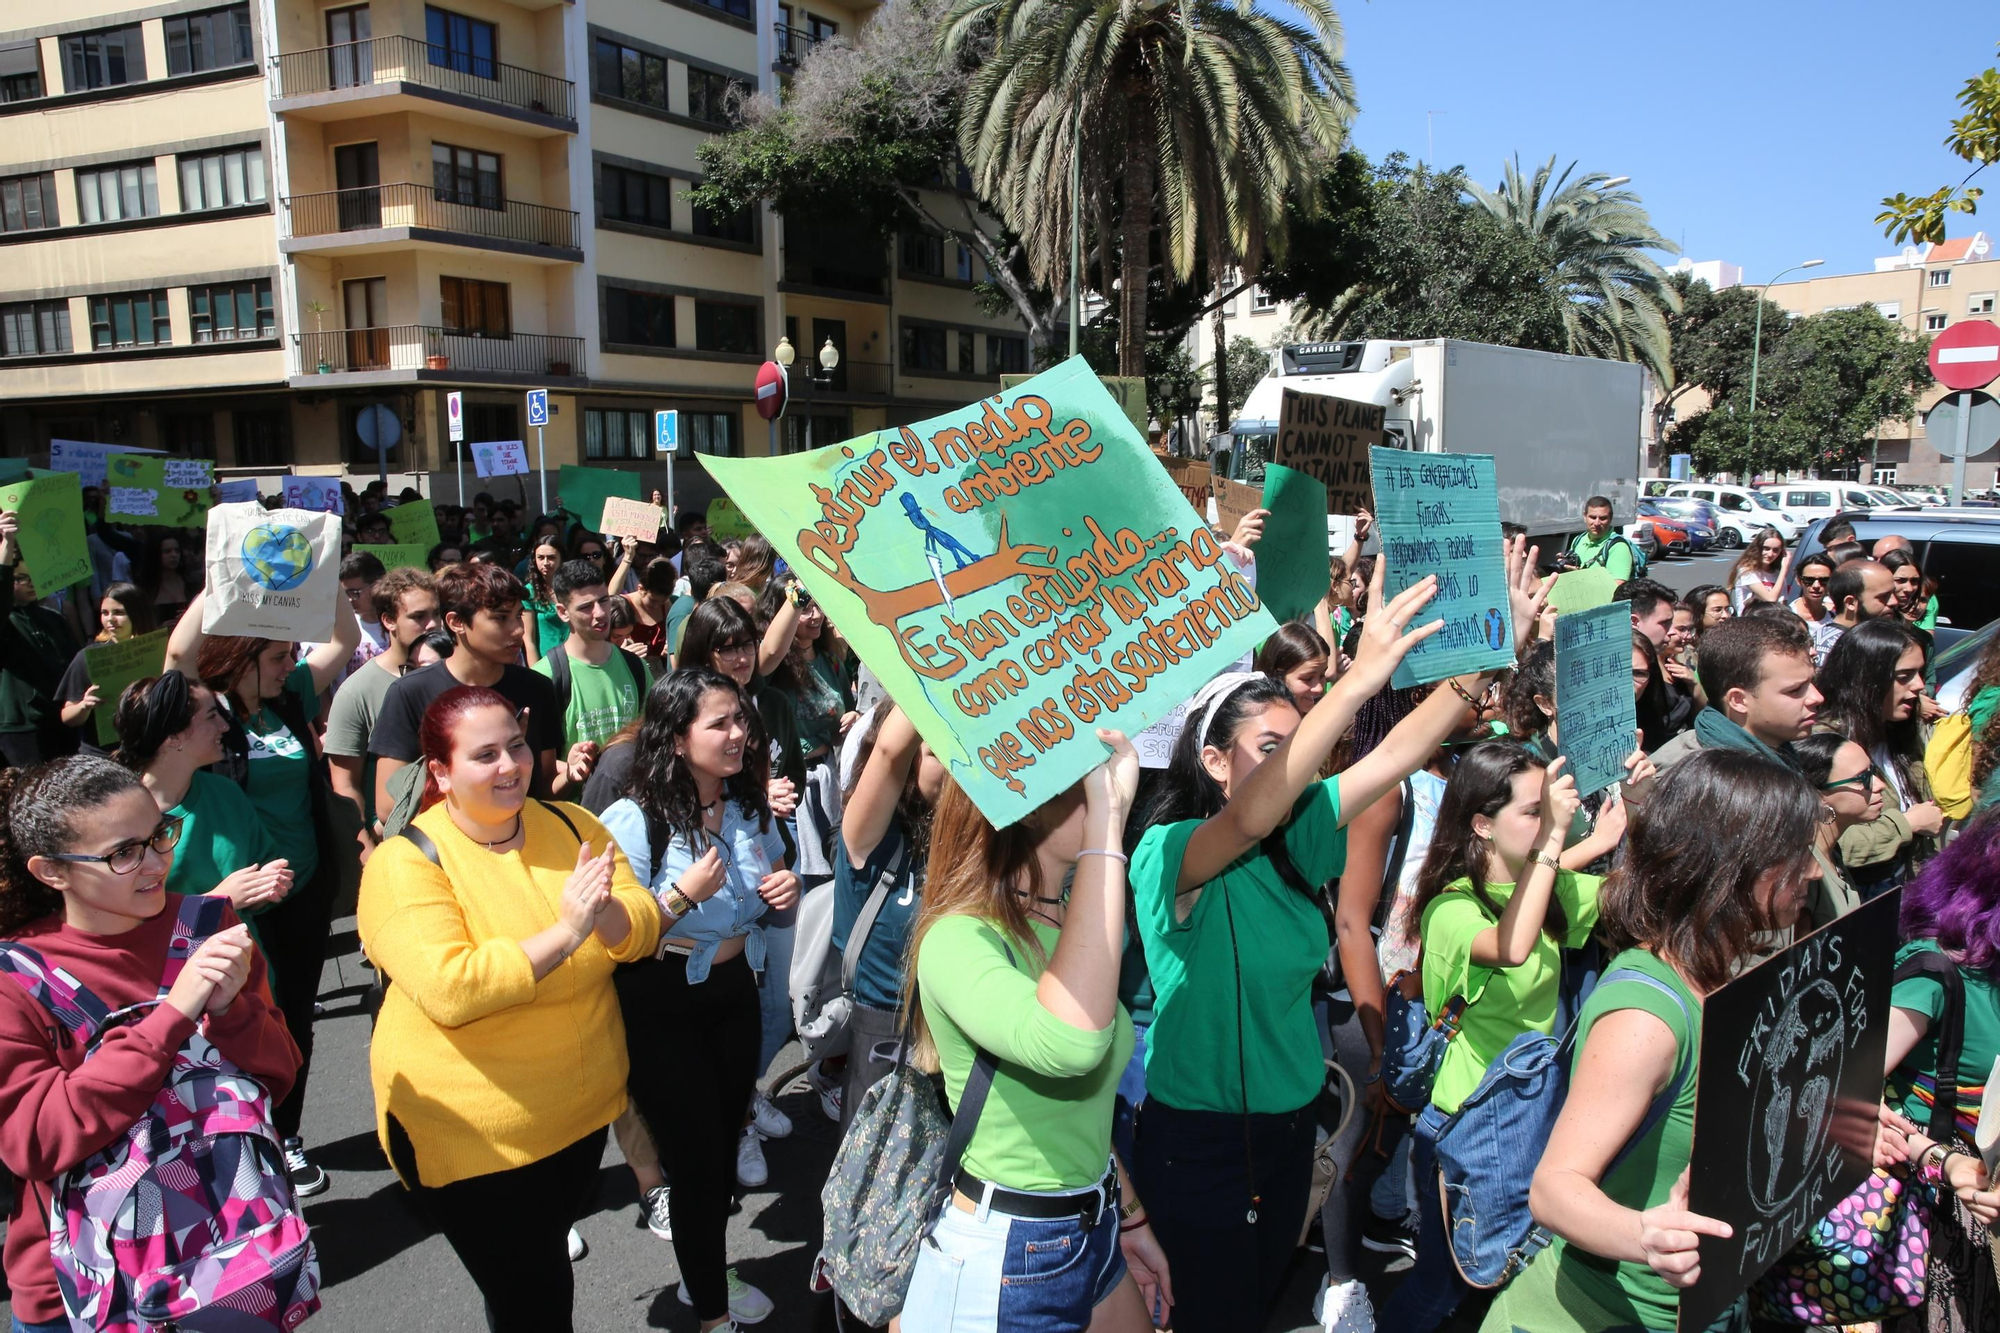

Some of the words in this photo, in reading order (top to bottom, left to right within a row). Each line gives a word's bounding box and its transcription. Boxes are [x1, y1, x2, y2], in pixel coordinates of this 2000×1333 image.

[1299, 345, 1341, 355] CARRIER
[1285, 391, 1328, 427] THIS
[1334, 401, 1386, 431] PLANET
[888, 426, 939, 477] el
[929, 395, 1053, 469] medio
[1282, 430, 1358, 458] CANNOT
[942, 418, 1103, 514] ambiente
[1385, 467, 1395, 492] A
[1400, 464, 1414, 488] LAS
[1420, 461, 1478, 490] GENERACIONES
[1445, 533, 1475, 560] PORQUE
[242, 592, 260, 604] KISS
[262, 595, 272, 605] MY
[273, 595, 301, 608] CANVAS
[1468, 574, 1479, 597] LO
[953, 659, 1029, 717] como
[1023, 603, 1112, 675] cortar
[1099, 585, 1148, 625] la
[1132, 527, 1223, 606] rama
[977, 731, 1036, 798] que
[1016, 698, 1075, 754] nos
[1111, 562, 1260, 692] sosteniendo
[1736, 934, 1844, 1088] FRIDAYS
[1843, 965, 1868, 1048] FOR
[1738, 1144, 1844, 1276] FUTURE
